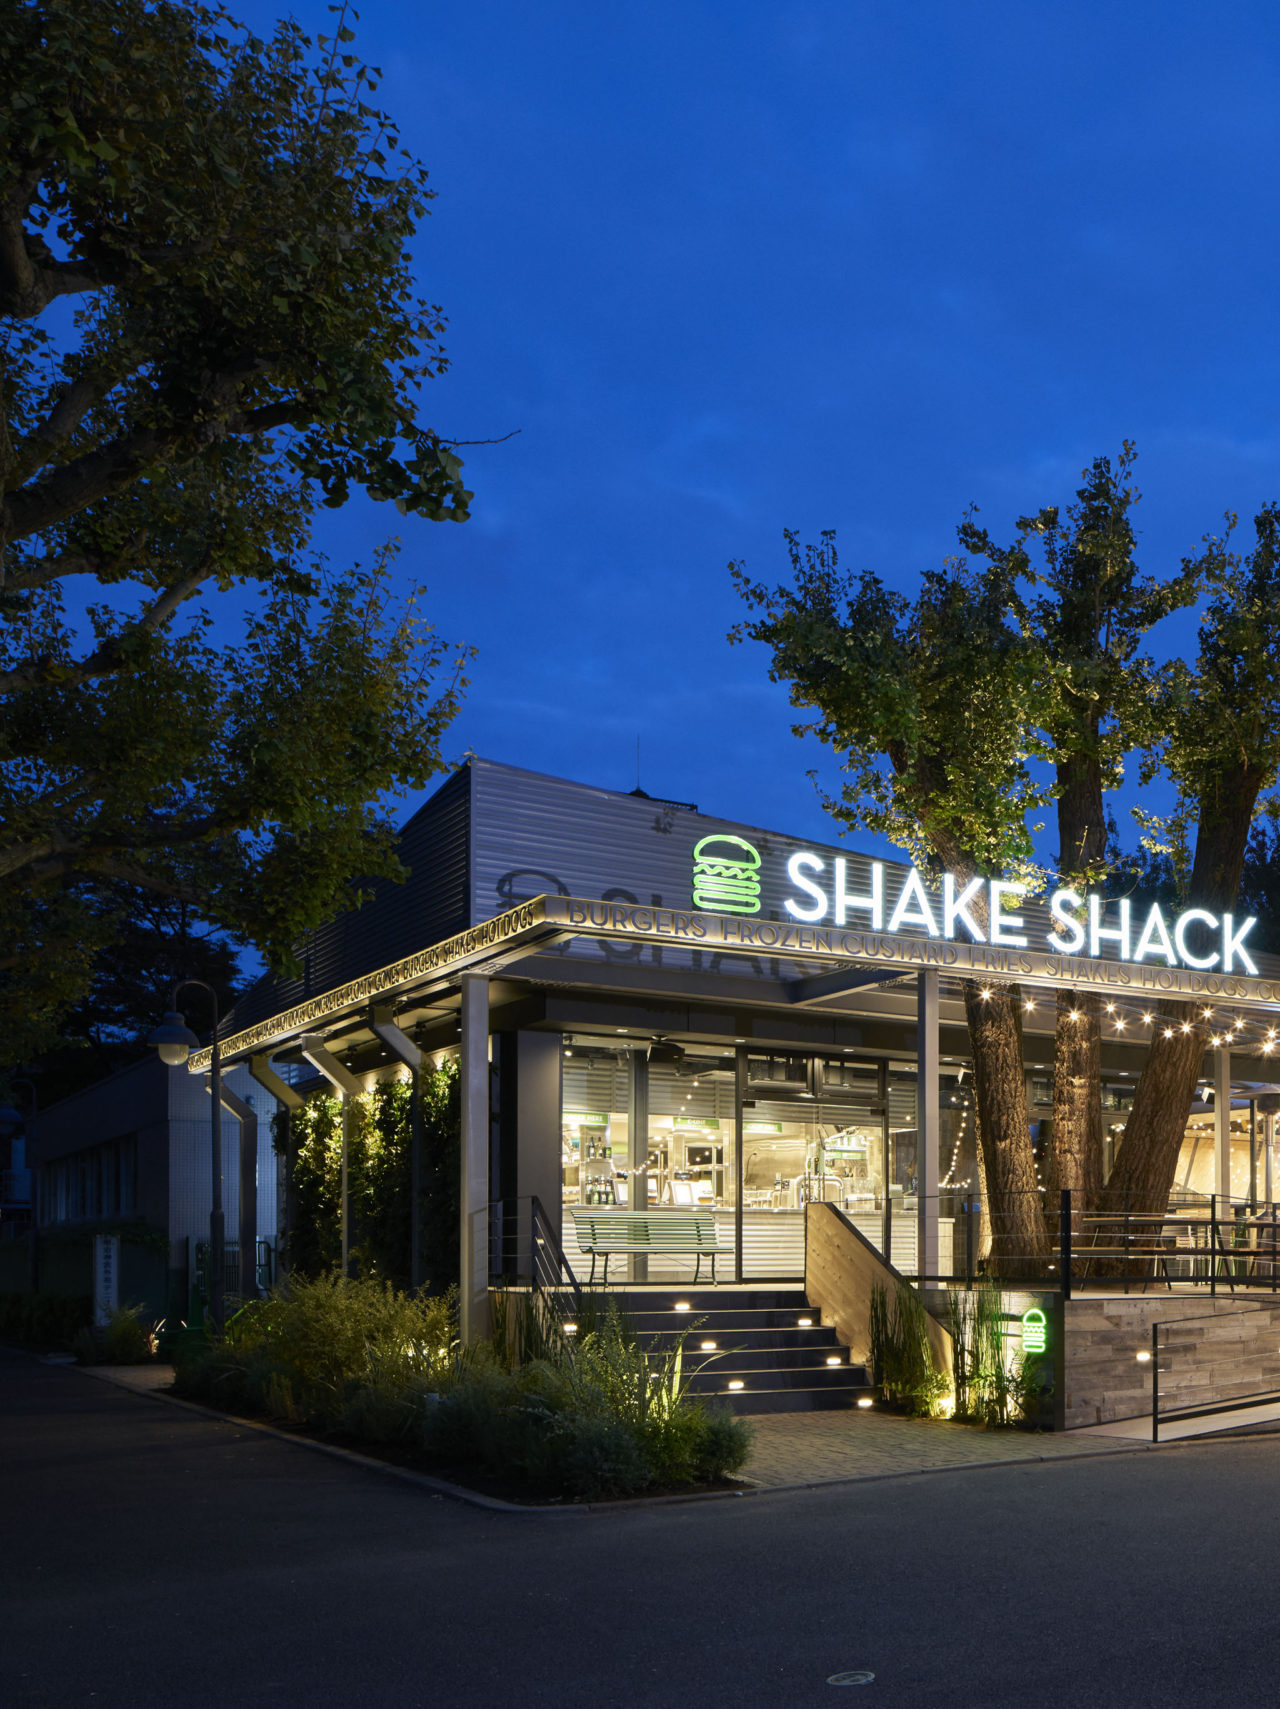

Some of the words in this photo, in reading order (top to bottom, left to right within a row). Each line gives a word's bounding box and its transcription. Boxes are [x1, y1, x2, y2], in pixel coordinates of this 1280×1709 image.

[403, 946, 439, 981] BURGERS
[443, 929, 478, 963] SHAKES
[569, 900, 707, 939] BURGERS
[721, 918, 833, 953] FROZEN
[841, 933, 959, 966] CUSTARD
[971, 945, 1033, 974] FRIES
[1046, 956, 1131, 985] SHAKES
[1141, 967, 1184, 991] HOT
[1190, 974, 1248, 998] DOGS
[784, 853, 1028, 947] SHAKE
[1047, 889, 1259, 976] SHACK
